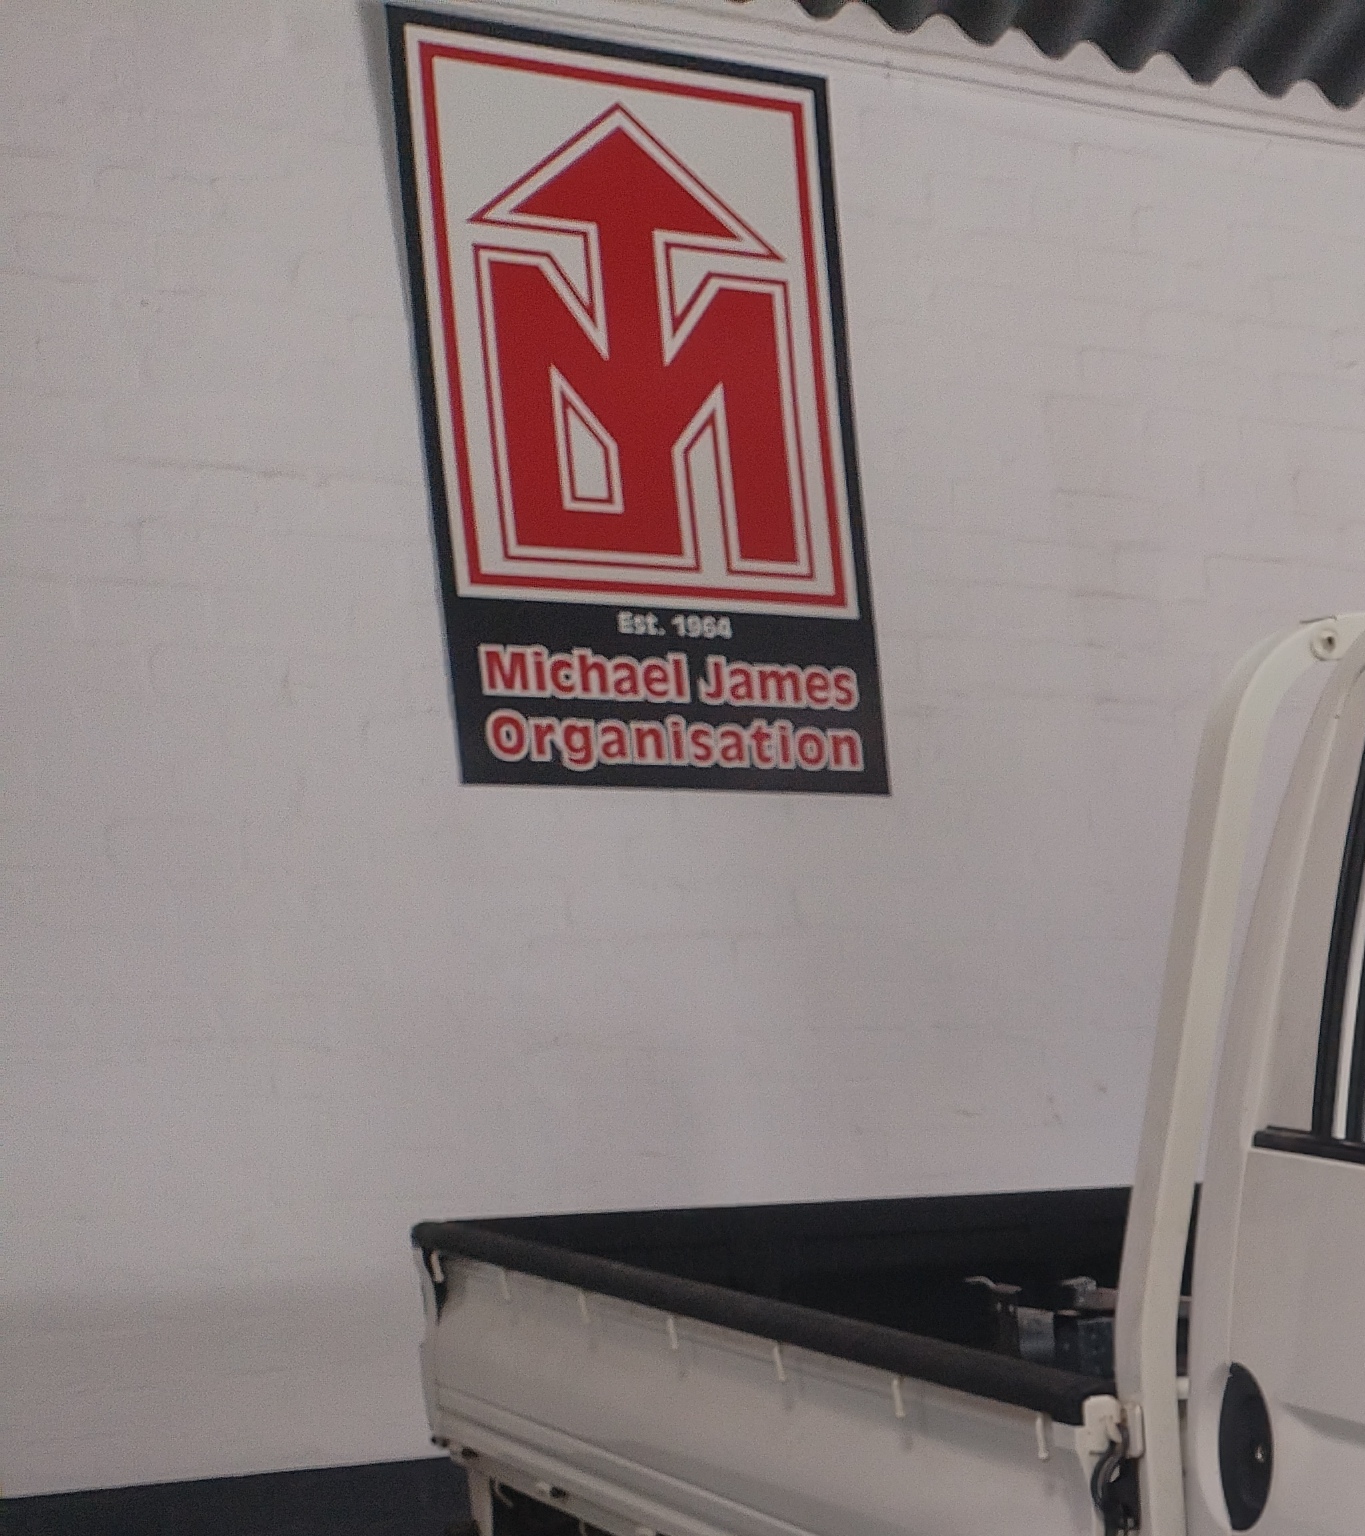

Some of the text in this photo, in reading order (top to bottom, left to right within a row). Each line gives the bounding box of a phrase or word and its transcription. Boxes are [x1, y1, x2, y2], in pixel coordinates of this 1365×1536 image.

[617, 611, 732, 639] Est. 1964
[479, 643, 859, 711] Michael James
[485, 708, 865, 771] Organisation
